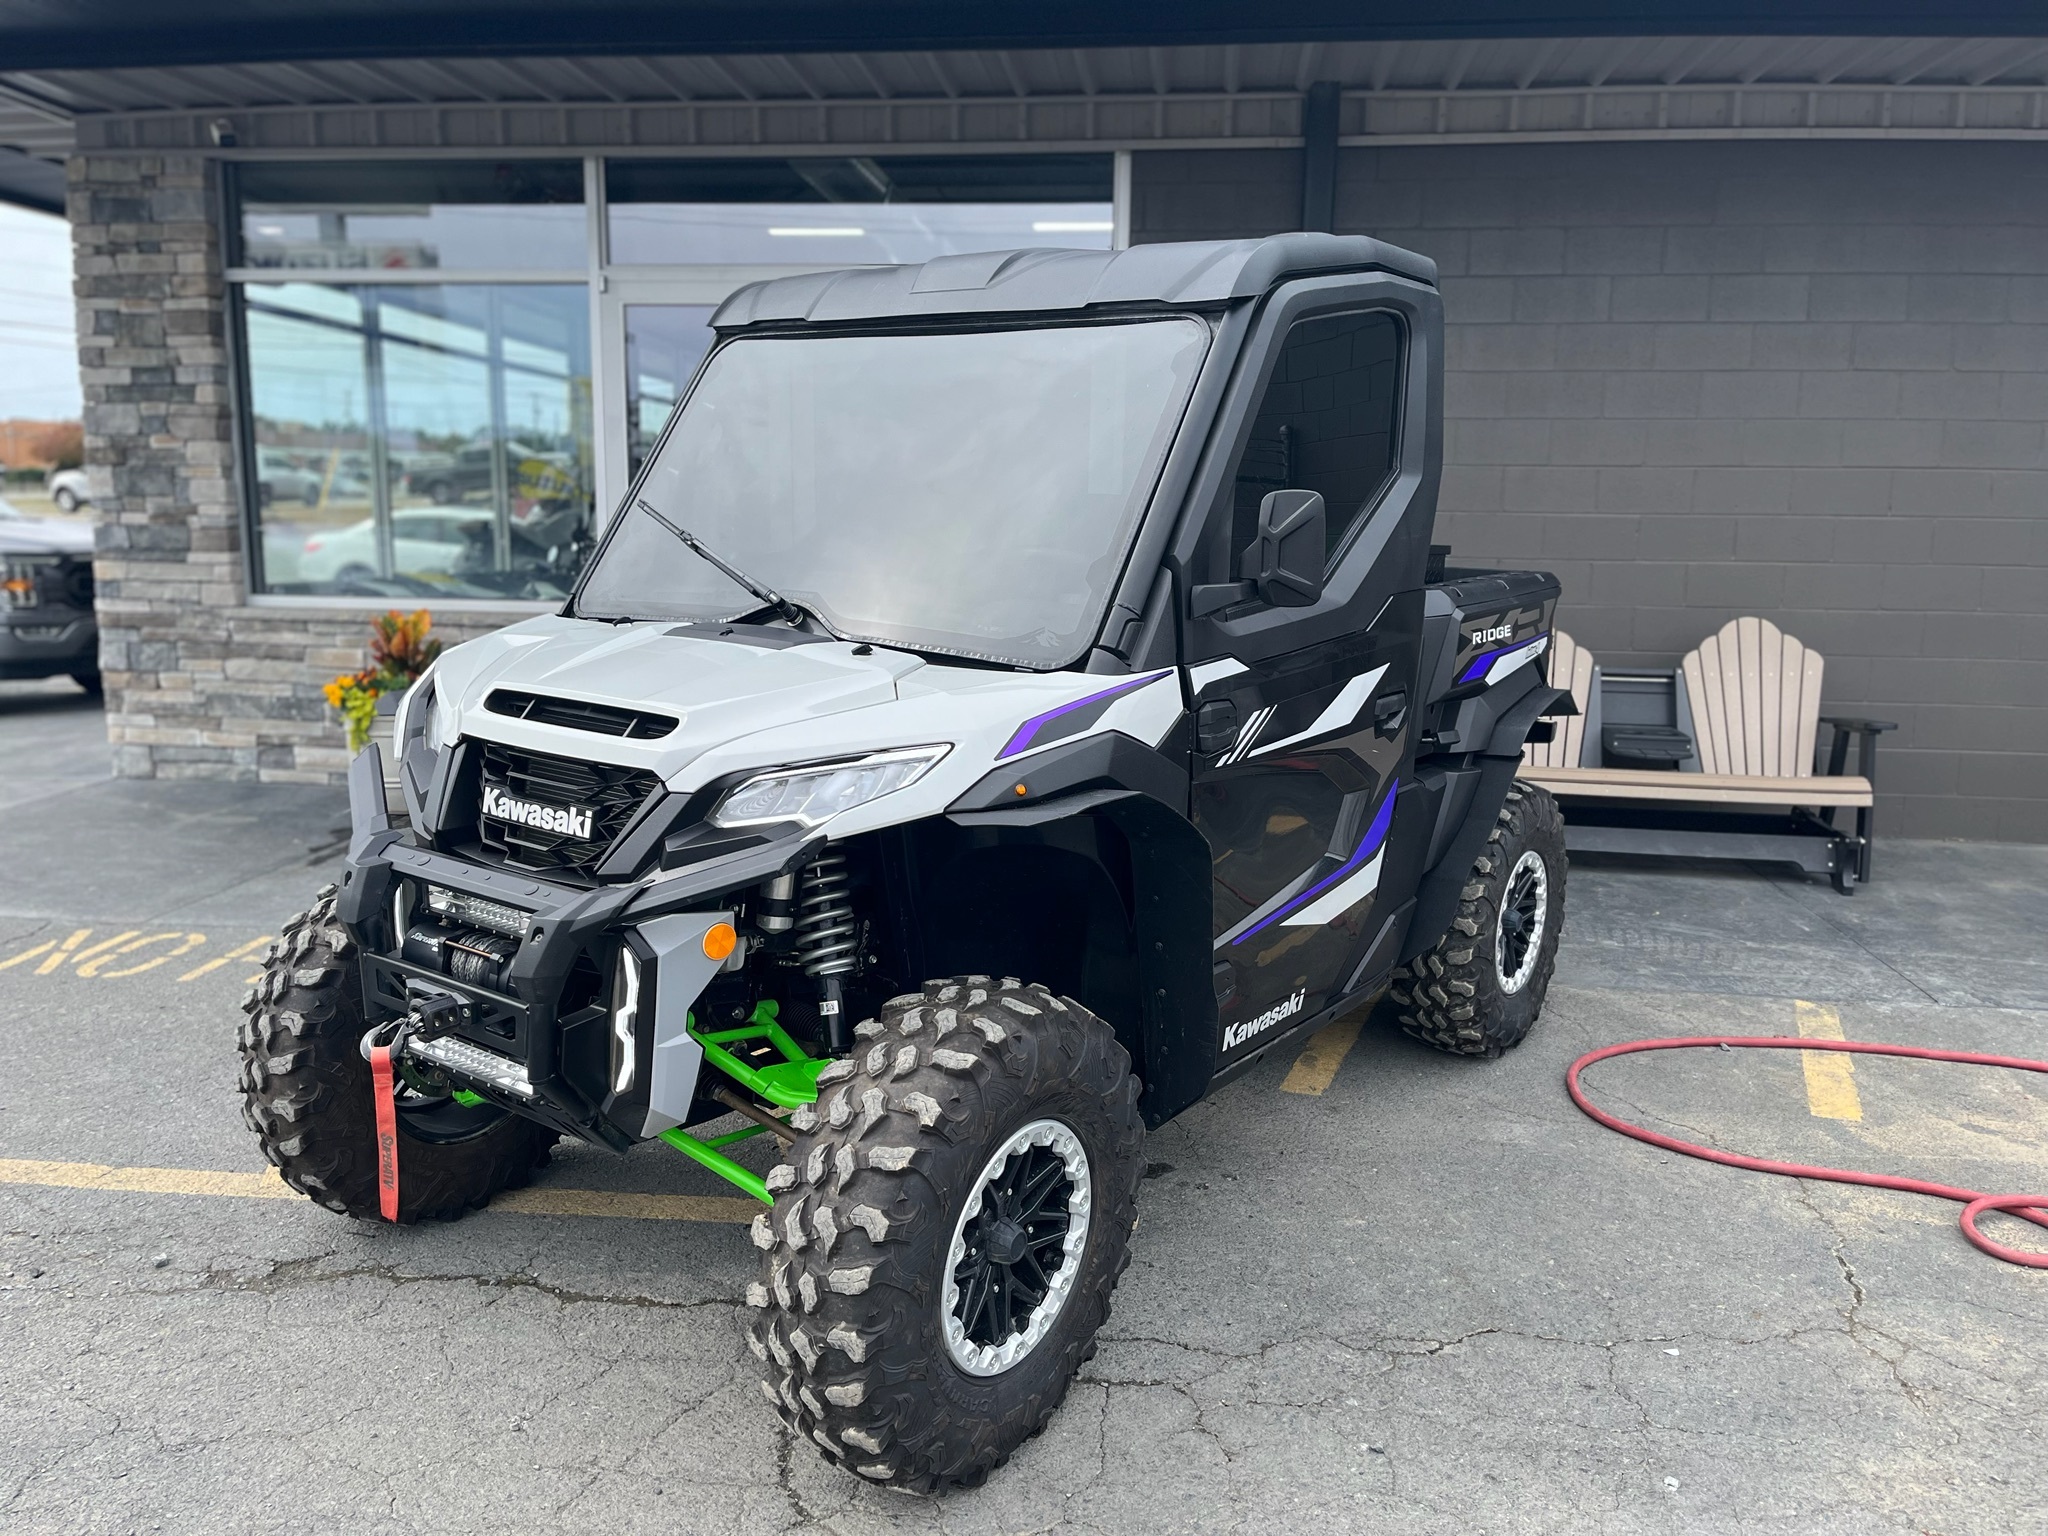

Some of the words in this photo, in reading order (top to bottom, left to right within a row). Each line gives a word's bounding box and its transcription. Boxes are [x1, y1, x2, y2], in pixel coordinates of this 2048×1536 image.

[1472, 624, 1512, 645] RIDGE
[482, 786, 593, 839] Kawasaki
[1222, 988, 1306, 1052] Kawasaki
